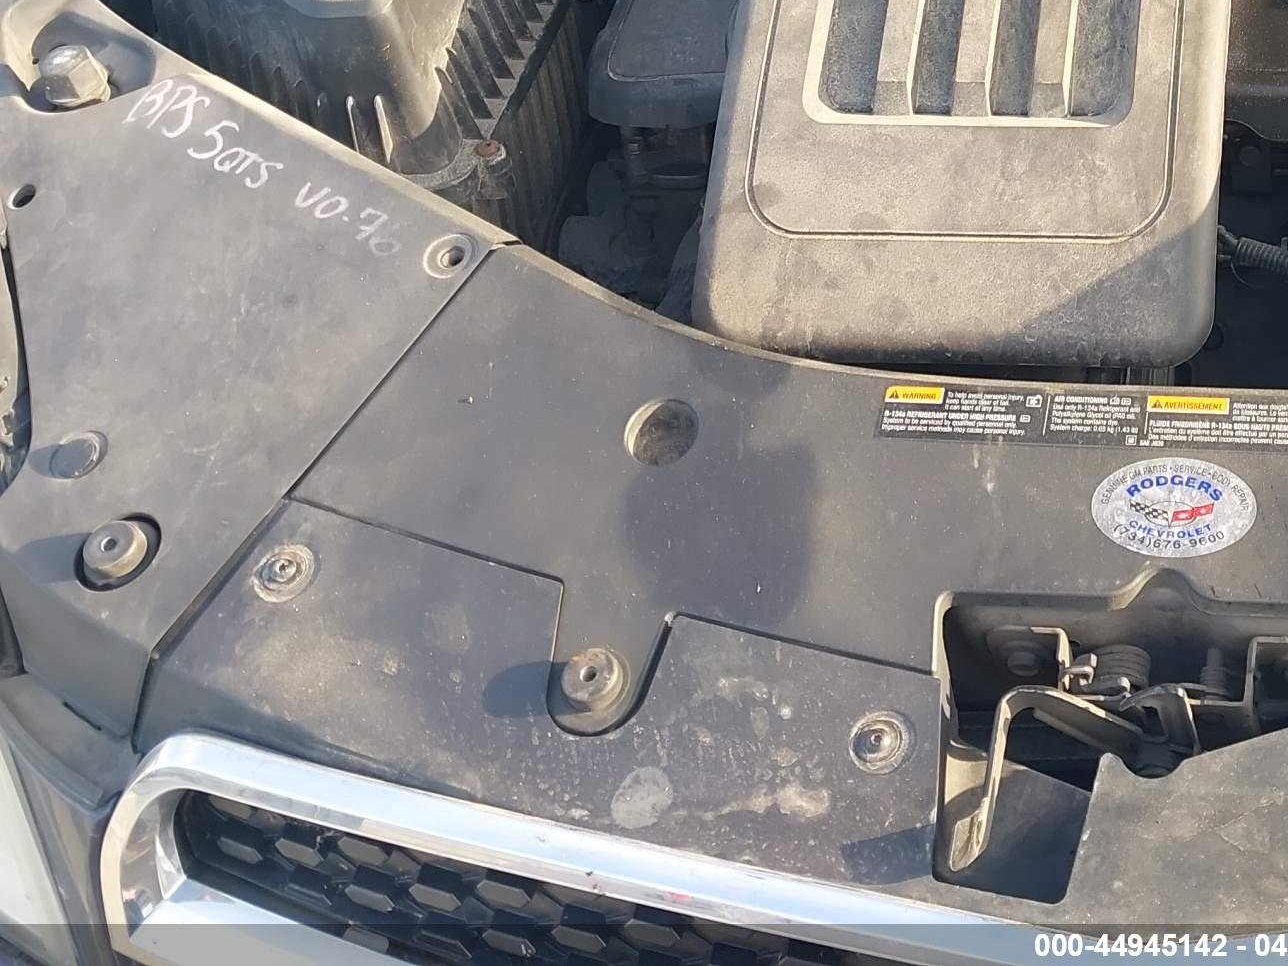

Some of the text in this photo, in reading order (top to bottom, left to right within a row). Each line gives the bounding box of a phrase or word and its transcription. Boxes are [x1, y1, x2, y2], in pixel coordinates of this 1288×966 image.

[902, 392, 937, 400] WARNING
[1164, 401, 1224, 411] AVERTISSEMENT
[1101, 464, 1249, 512] GENUINE GM PARTS SERVICE BODY REPAIR
[1126, 474, 1223, 502] RODGERS
[1129, 520, 1212, 539] CHEVROLET
